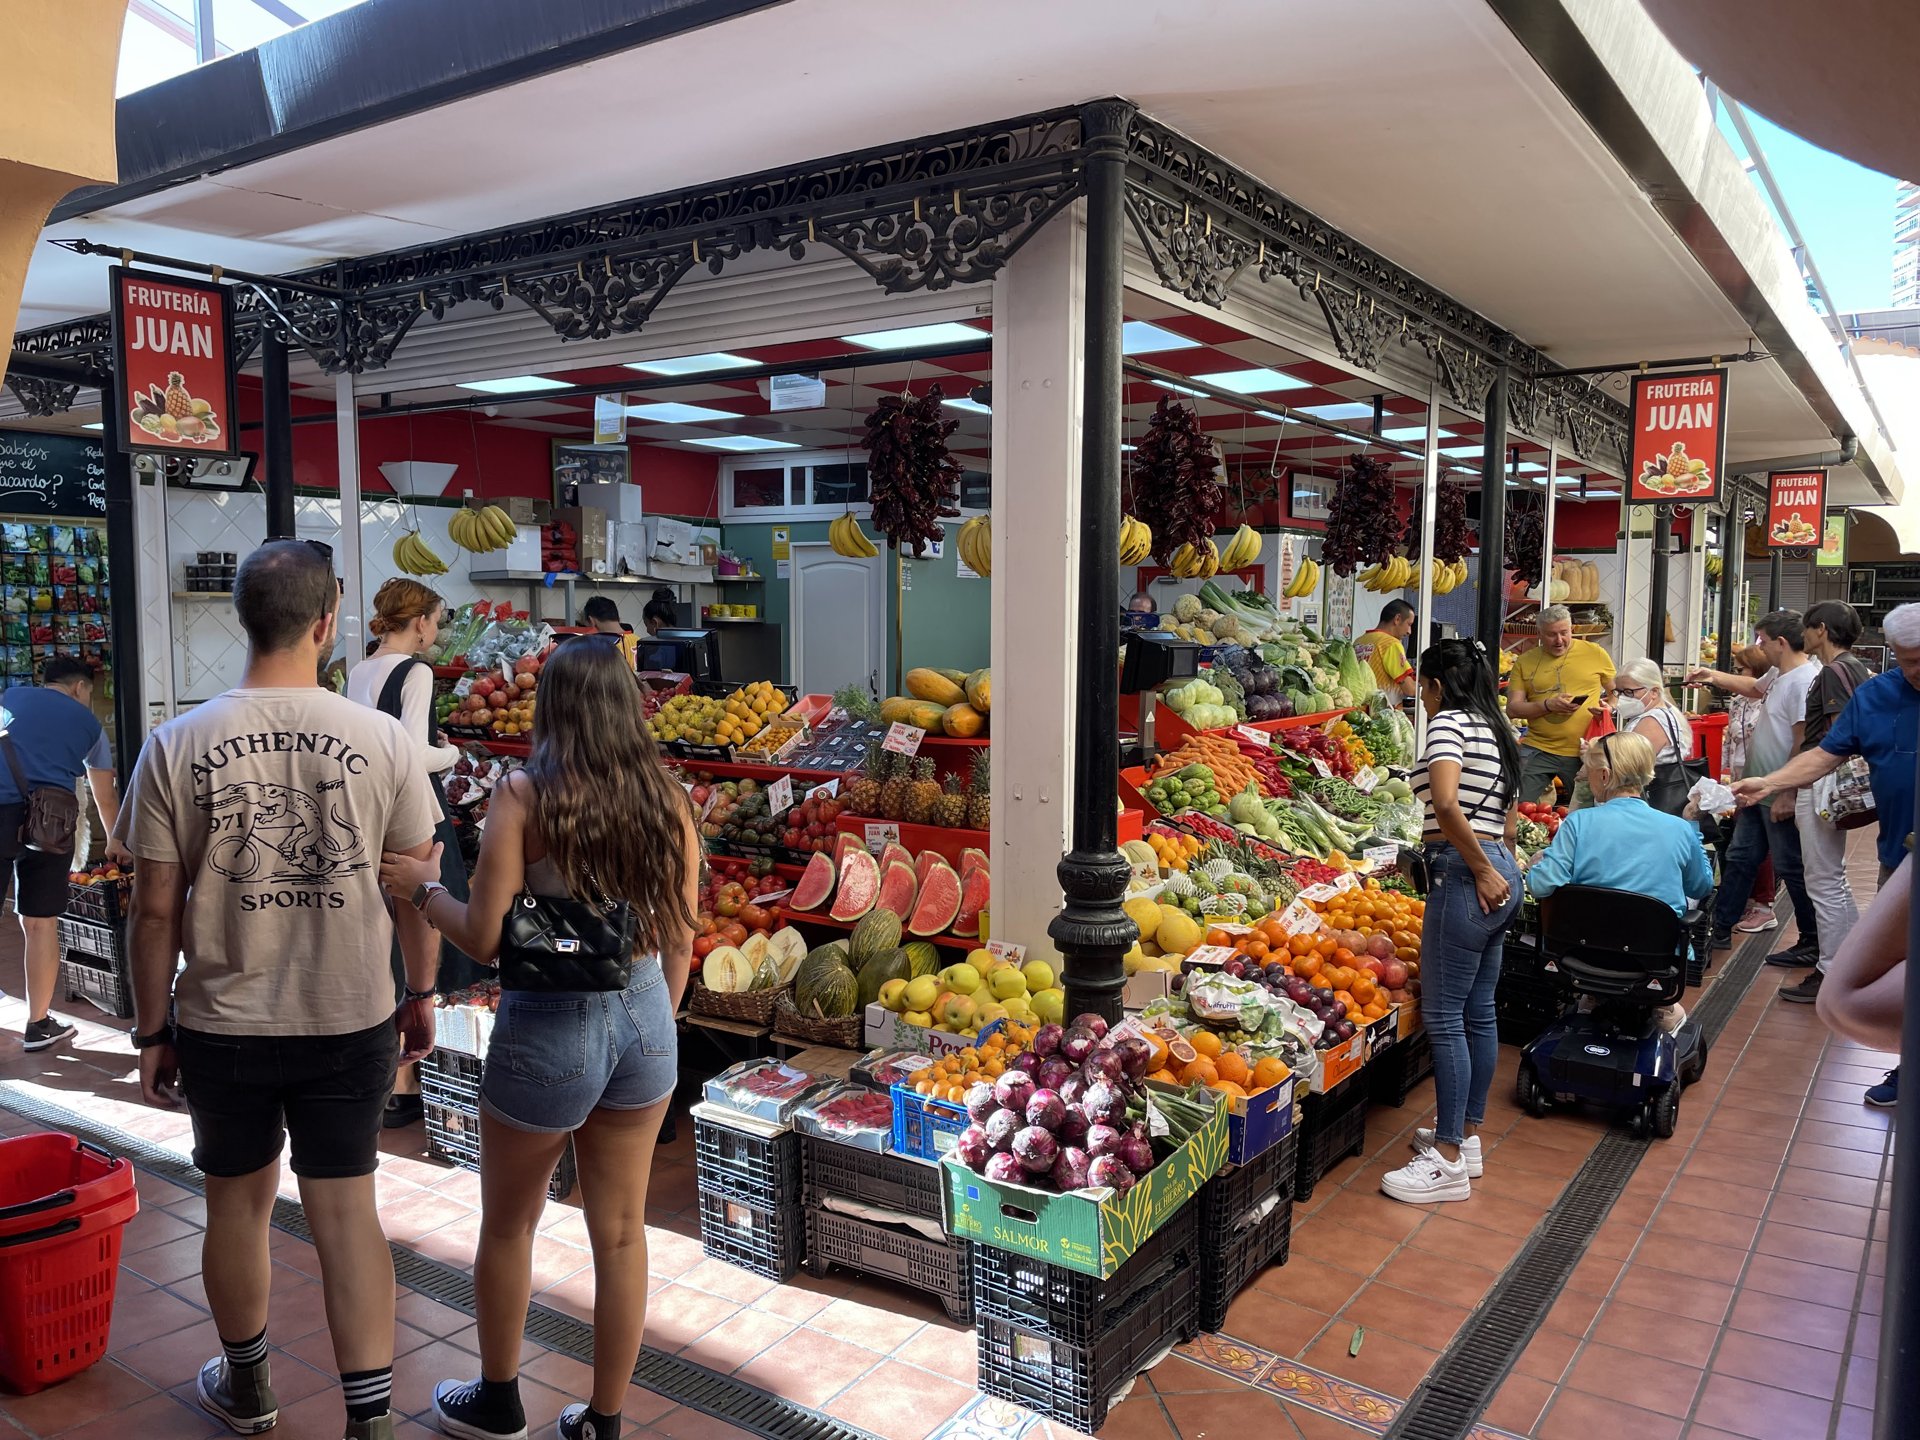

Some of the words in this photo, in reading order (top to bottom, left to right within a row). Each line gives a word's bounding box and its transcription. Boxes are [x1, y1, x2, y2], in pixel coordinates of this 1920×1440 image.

[128, 285, 211, 316] FRUTERÍA
[131, 315, 213, 359] JUAN
[1646, 379, 1714, 400] FRUTERÍA
[1645, 402, 1714, 432] JUAN
[20, 458, 36, 471] el
[1775, 476, 1818, 487] FRUTERÍA
[1775, 489, 1818, 507] JUAN
[190, 731, 369, 785] AUTHENTIC
[240, 890, 345, 912] SPORTS
[994, 1226, 1049, 1254] SALMOR
